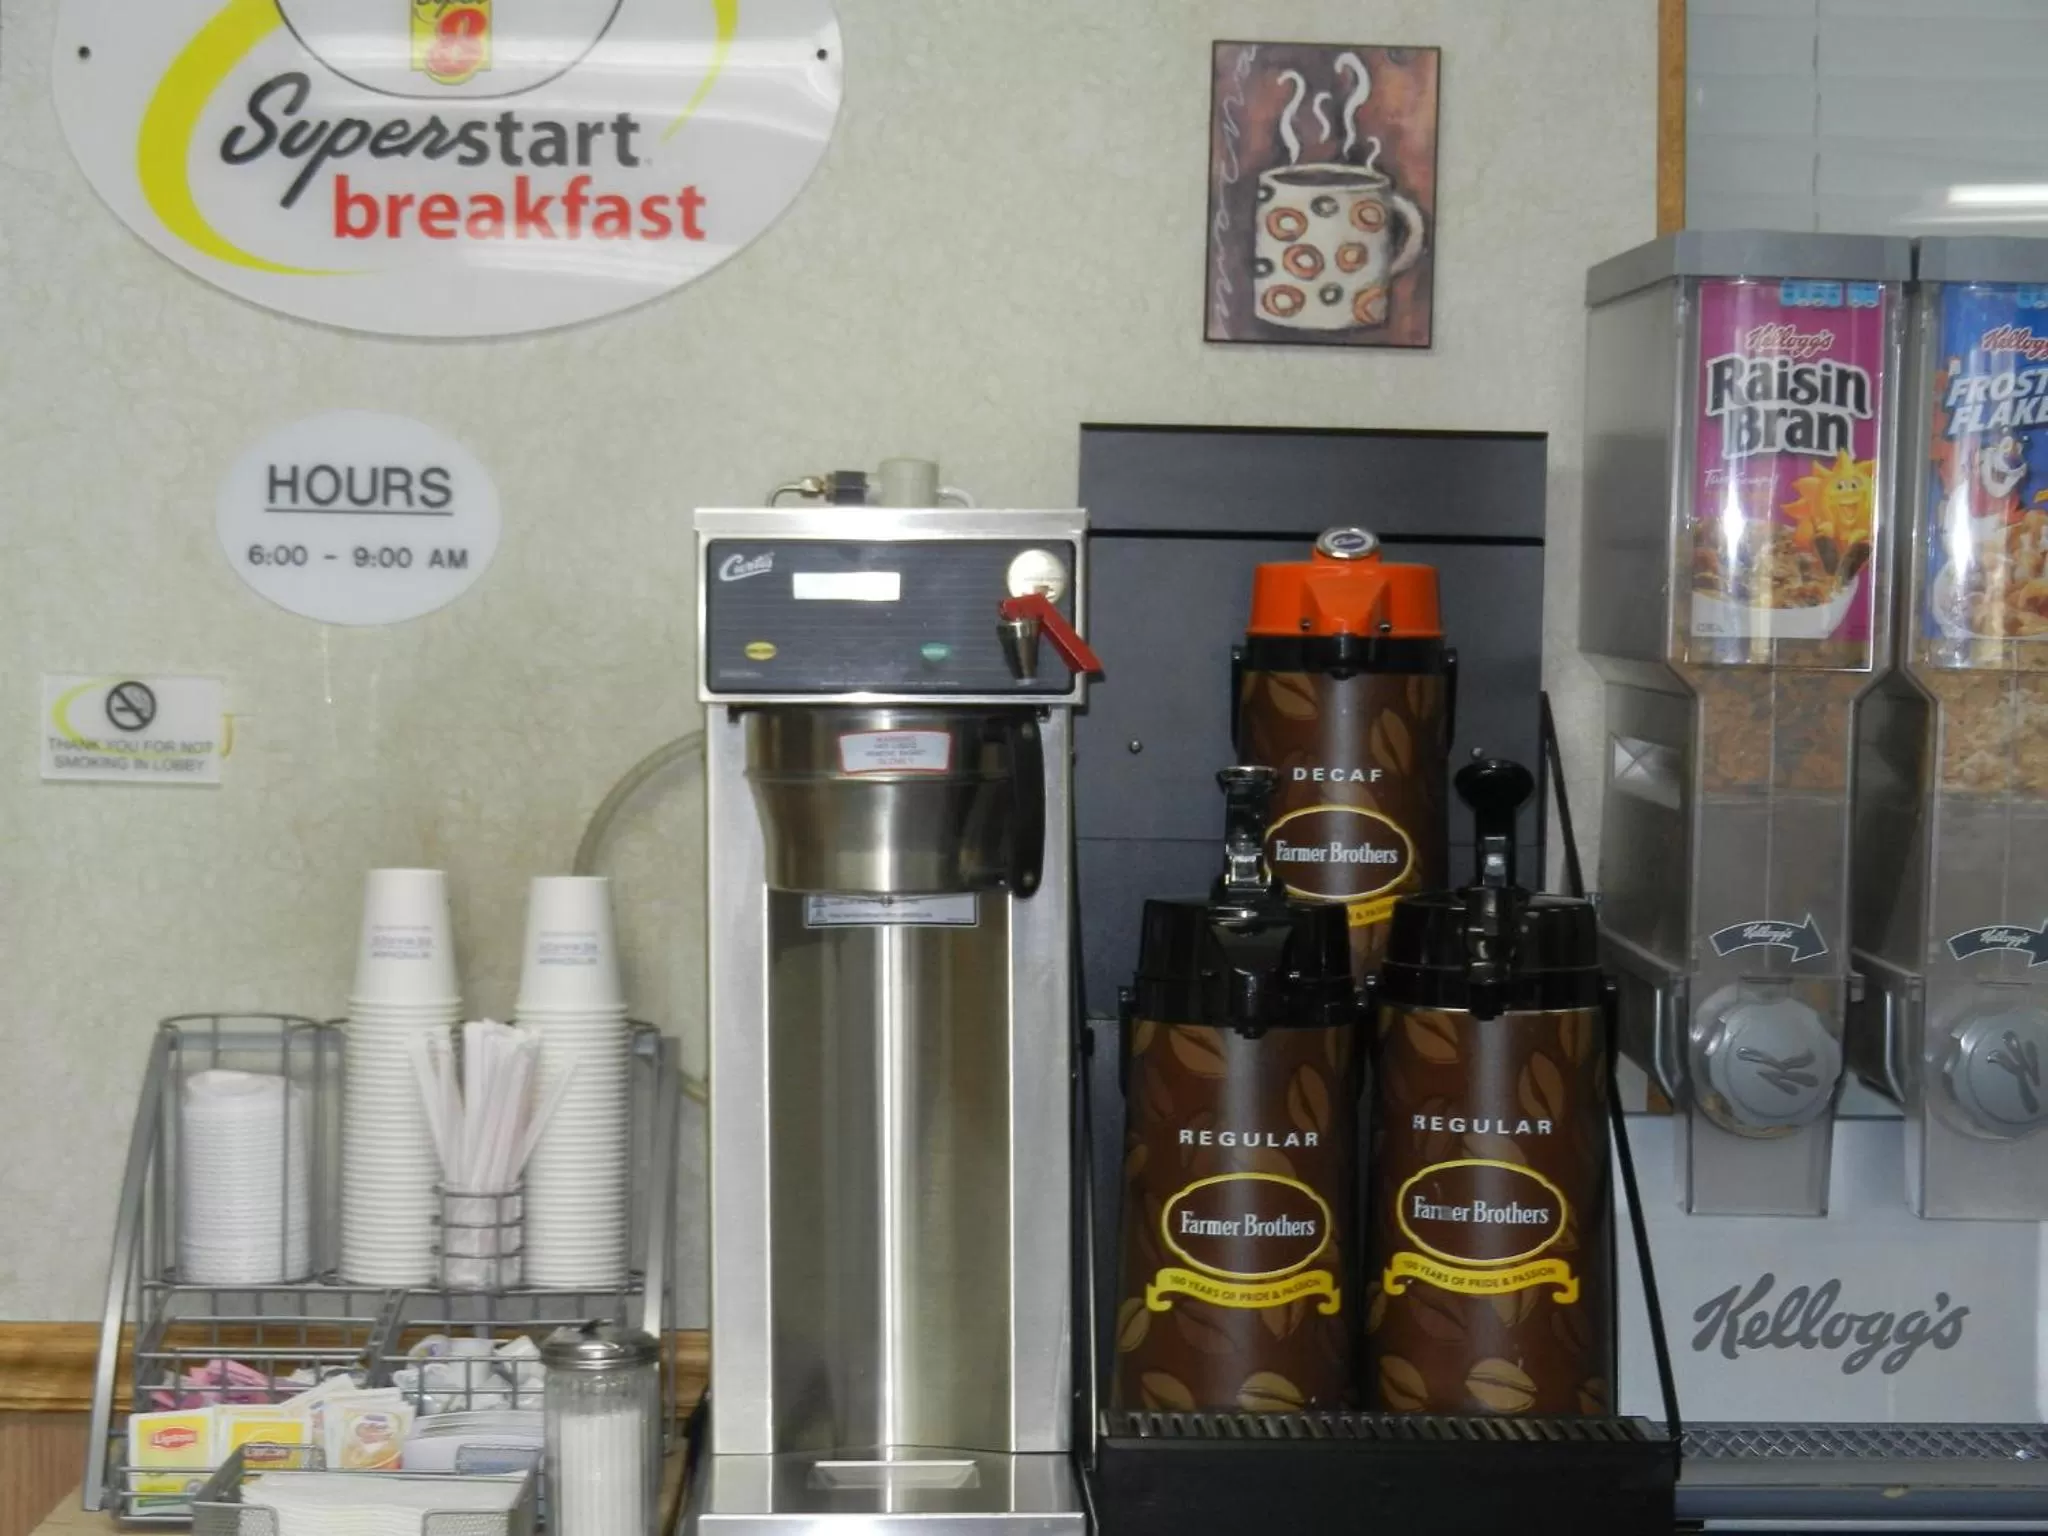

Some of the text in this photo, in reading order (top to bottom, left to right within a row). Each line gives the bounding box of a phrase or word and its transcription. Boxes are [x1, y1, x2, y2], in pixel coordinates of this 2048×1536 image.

[221, 72, 641, 208] Superstart
[333, 175, 707, 240] breakfast
[1745, 323, 1835, 358] Kellogg's
[1707, 354, 1872, 418] Raisin
[1722, 405, 1853, 459] Bran
[267, 464, 453, 509] HOURS
[248, 545, 308, 567] 6:00
[353, 547, 413, 569] 9:00
[428, 548, 470, 569] AM
[1292, 767, 1384, 783] DECAF
[1274, 840, 1399, 864] Farmer Brothers
[1413, 1114, 1553, 1135] REGULAR
[1178, 1129, 1320, 1148] REGULAR
[1179, 1210, 1316, 1237] Farmer Brothers
[1473, 1200, 1549, 1224] Brothers
[1420, 1265, 1449, 1284] YEARS
[1451, 1275, 1466, 1287] OF
[1468, 1278, 1499, 1289] PRIDE
[1512, 1266, 1557, 1283] PASSION
[1187, 1280, 1220, 1298] YEARS
[1221, 1290, 1237, 1301] OF
[1239, 1292, 1270, 1302] PRIDE
[1691, 1272, 1972, 1375] Kellogg's
